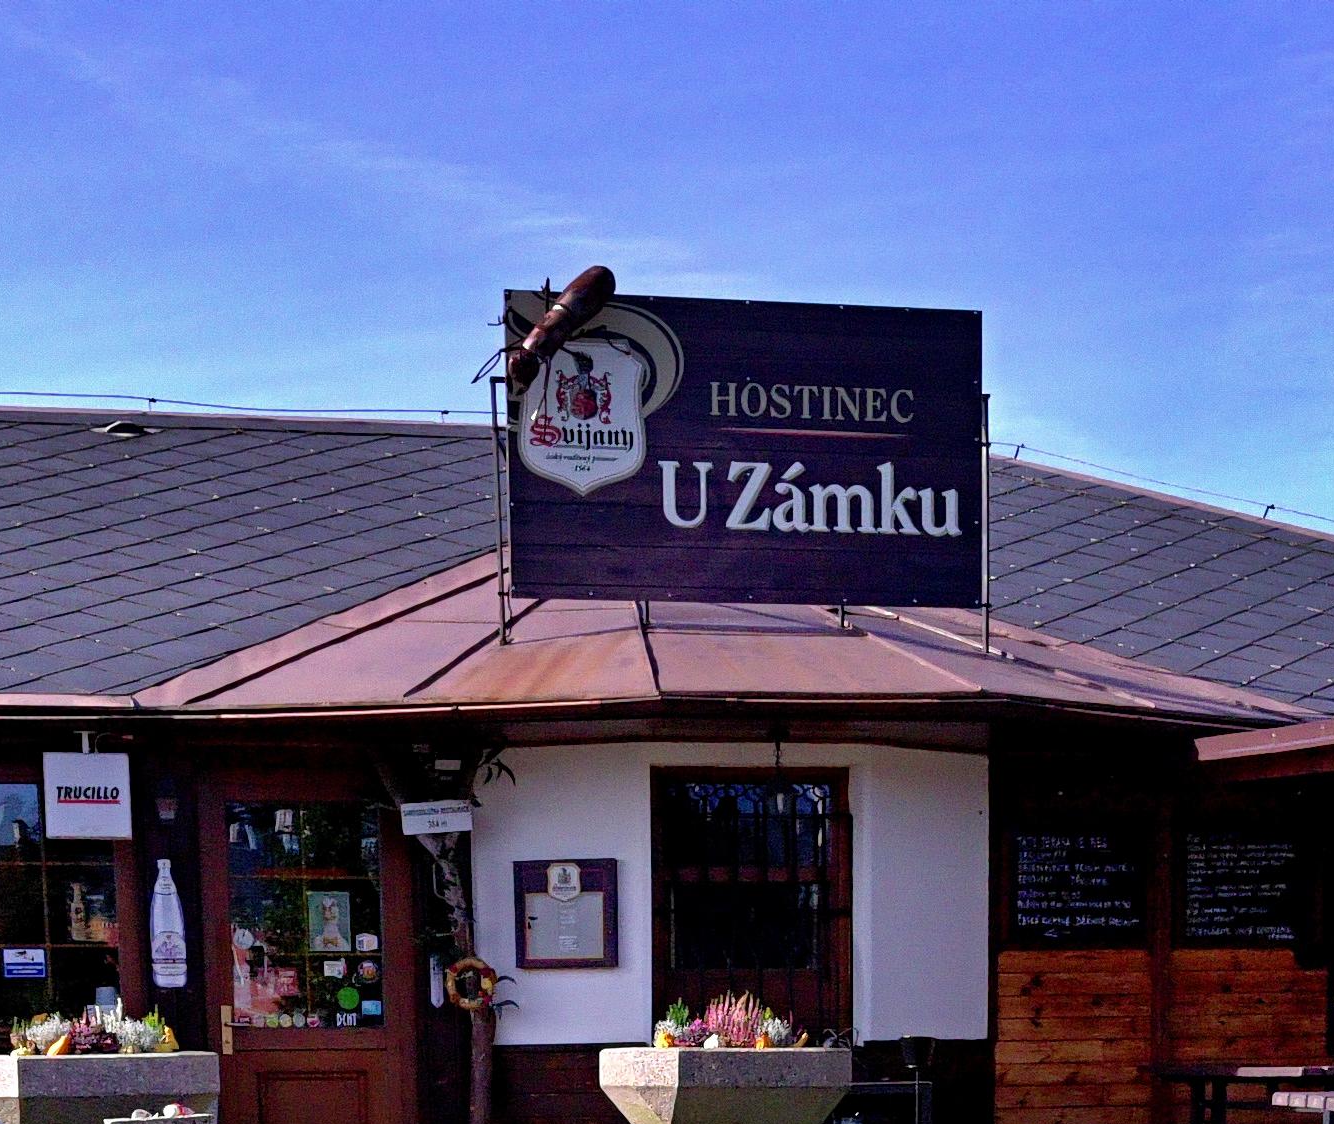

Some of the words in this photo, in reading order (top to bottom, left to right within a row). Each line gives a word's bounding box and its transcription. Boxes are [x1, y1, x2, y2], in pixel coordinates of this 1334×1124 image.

[709, 381, 915, 424] HOSTINEC
[530, 415, 634, 452] Svijany
[657, 460, 713, 529] U
[725, 461, 963, 537] Zámku
[56, 786, 120, 800] TRUCILLO
